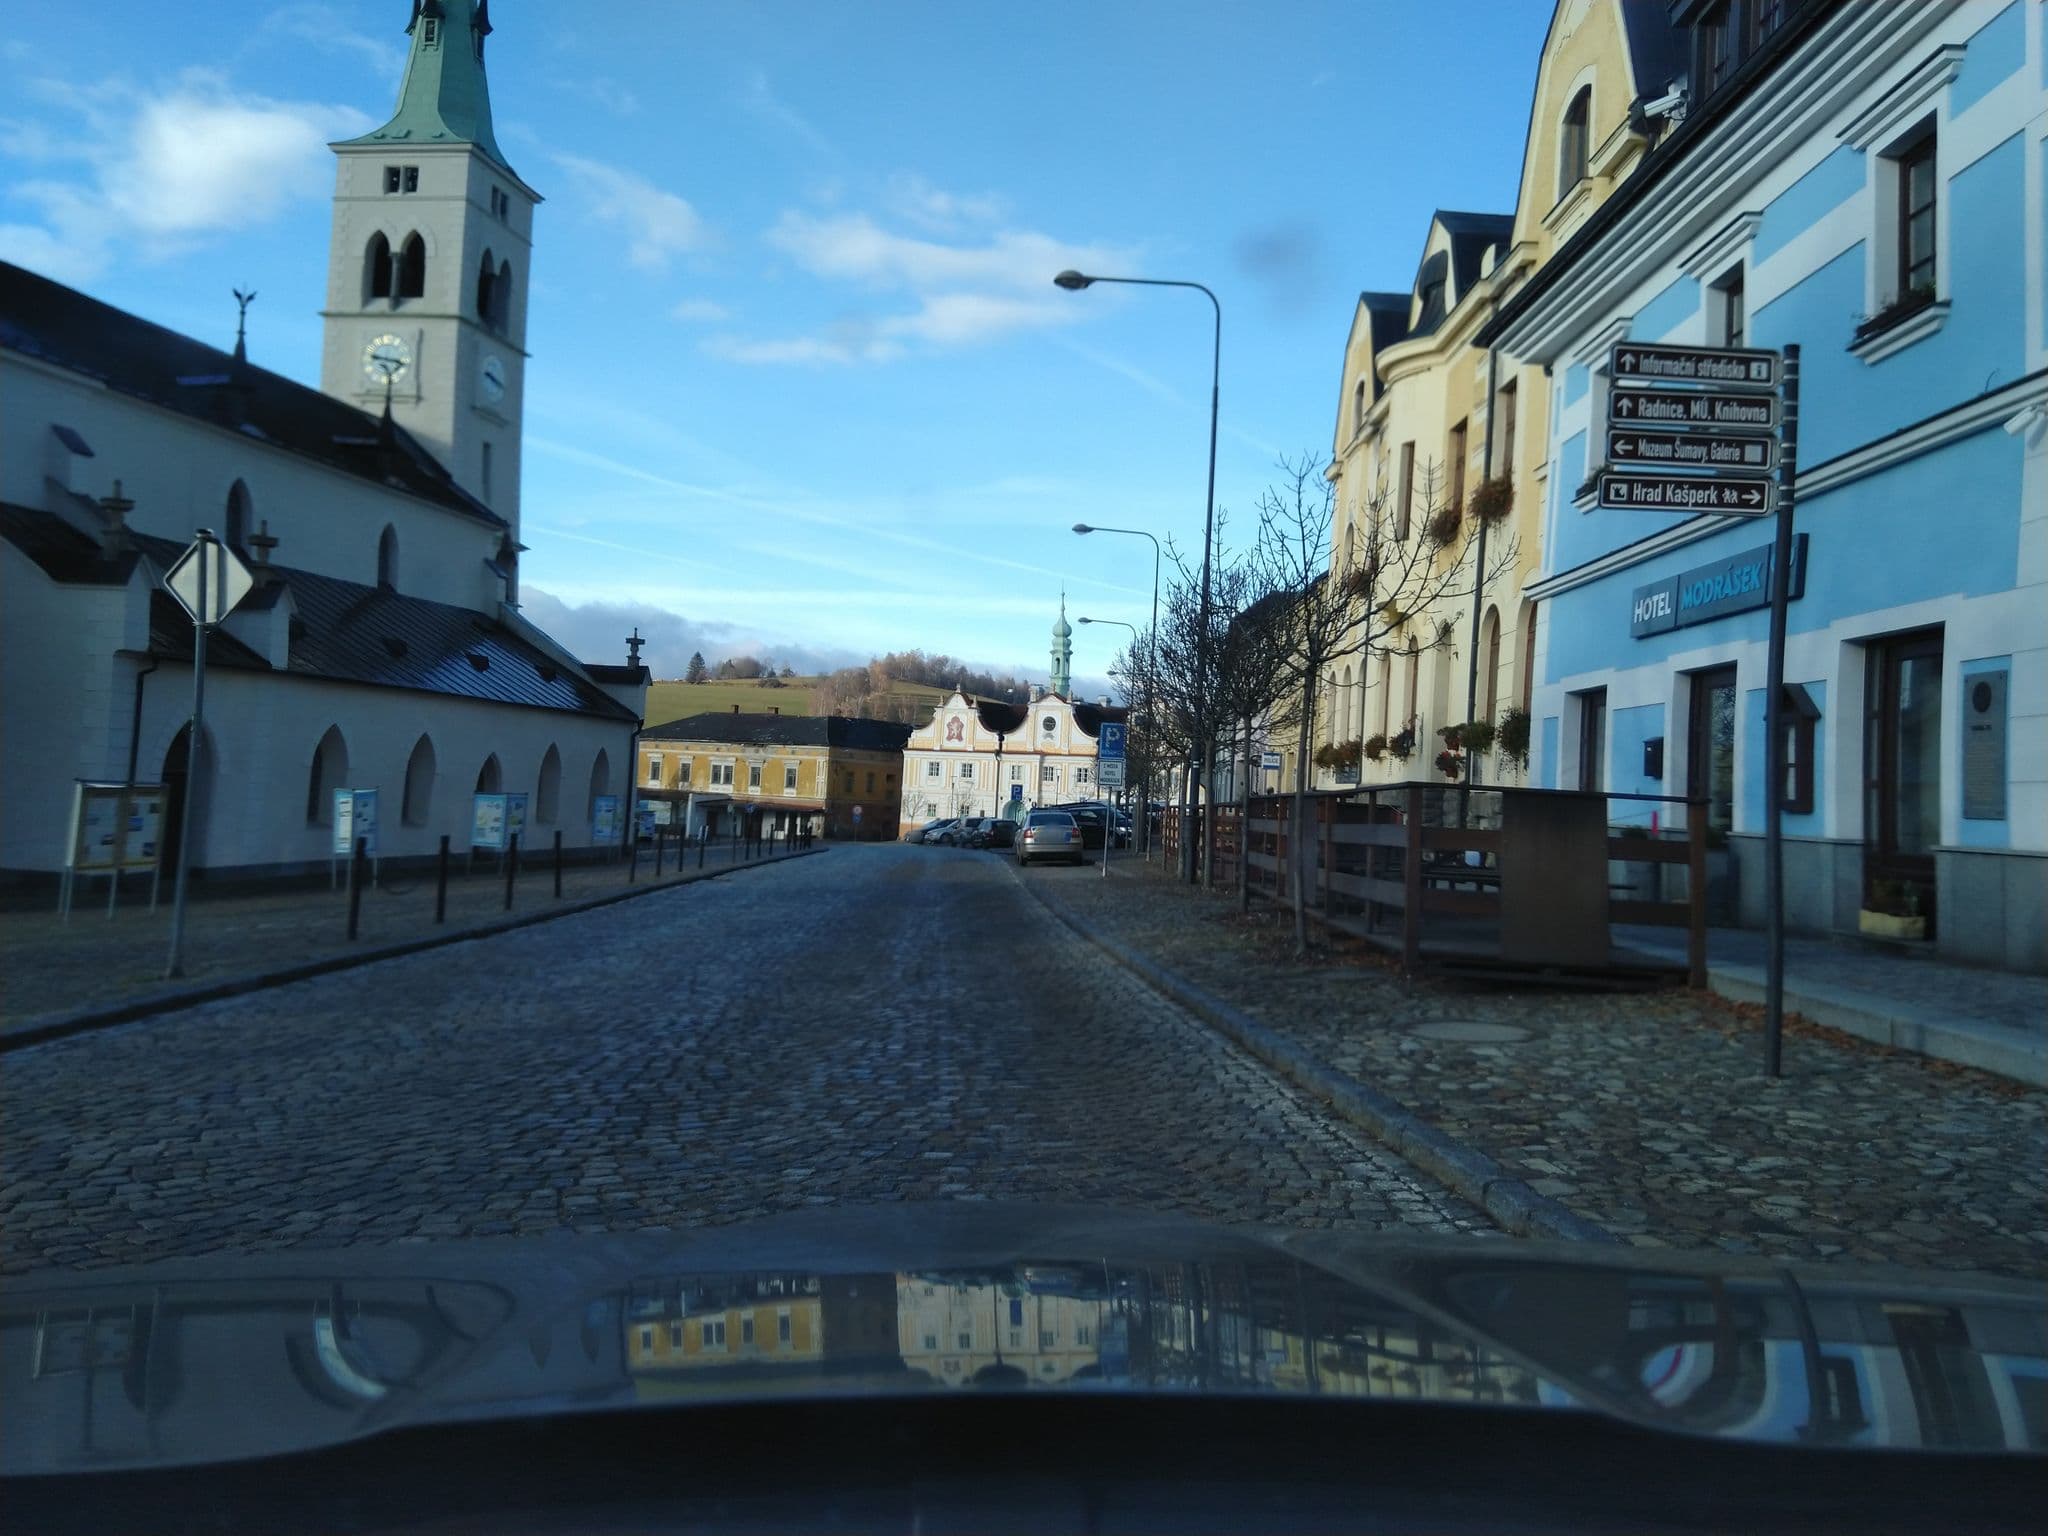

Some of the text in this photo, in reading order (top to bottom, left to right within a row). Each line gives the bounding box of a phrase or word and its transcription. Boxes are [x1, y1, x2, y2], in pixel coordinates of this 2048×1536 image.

[1640, 354, 1696, 376] Informační
[1697, 359, 1746, 379] středisko
[1714, 401, 1767, 421] Knihovna
[1638, 438, 1672, 457] Muzeum
[1710, 442, 1740, 461] Galerie
[1633, 483, 1718, 508] Hrad Kašperk
[1634, 563, 1763, 624] HOTEL MODRÁSEK
[1106, 727, 1120, 747] P
